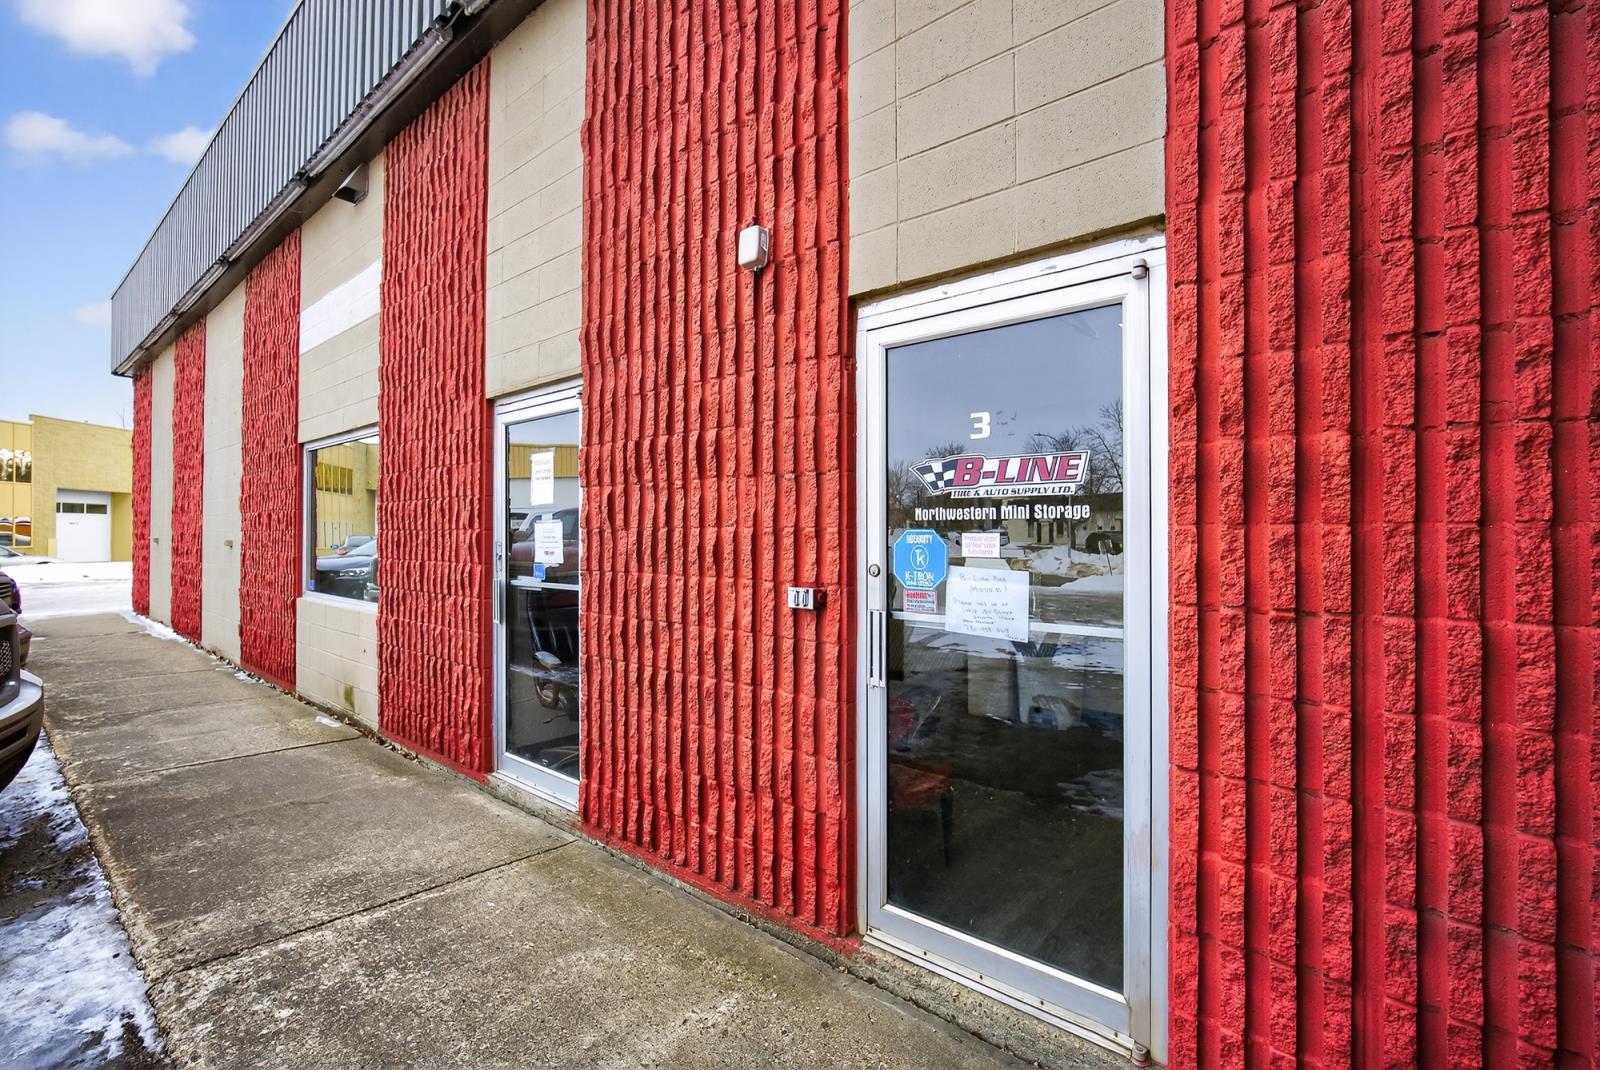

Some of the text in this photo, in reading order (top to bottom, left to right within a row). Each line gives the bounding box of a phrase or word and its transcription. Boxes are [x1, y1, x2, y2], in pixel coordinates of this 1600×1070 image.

[969, 411, 991, 440] 3
[953, 455, 1082, 487] B-LINE
[983, 487, 1009, 496] AUTO
[1010, 486, 1050, 496] SUPPLY
[1051, 485, 1074, 494] LTD.
[915, 503, 1091, 521] Northwestern Mini Storage
